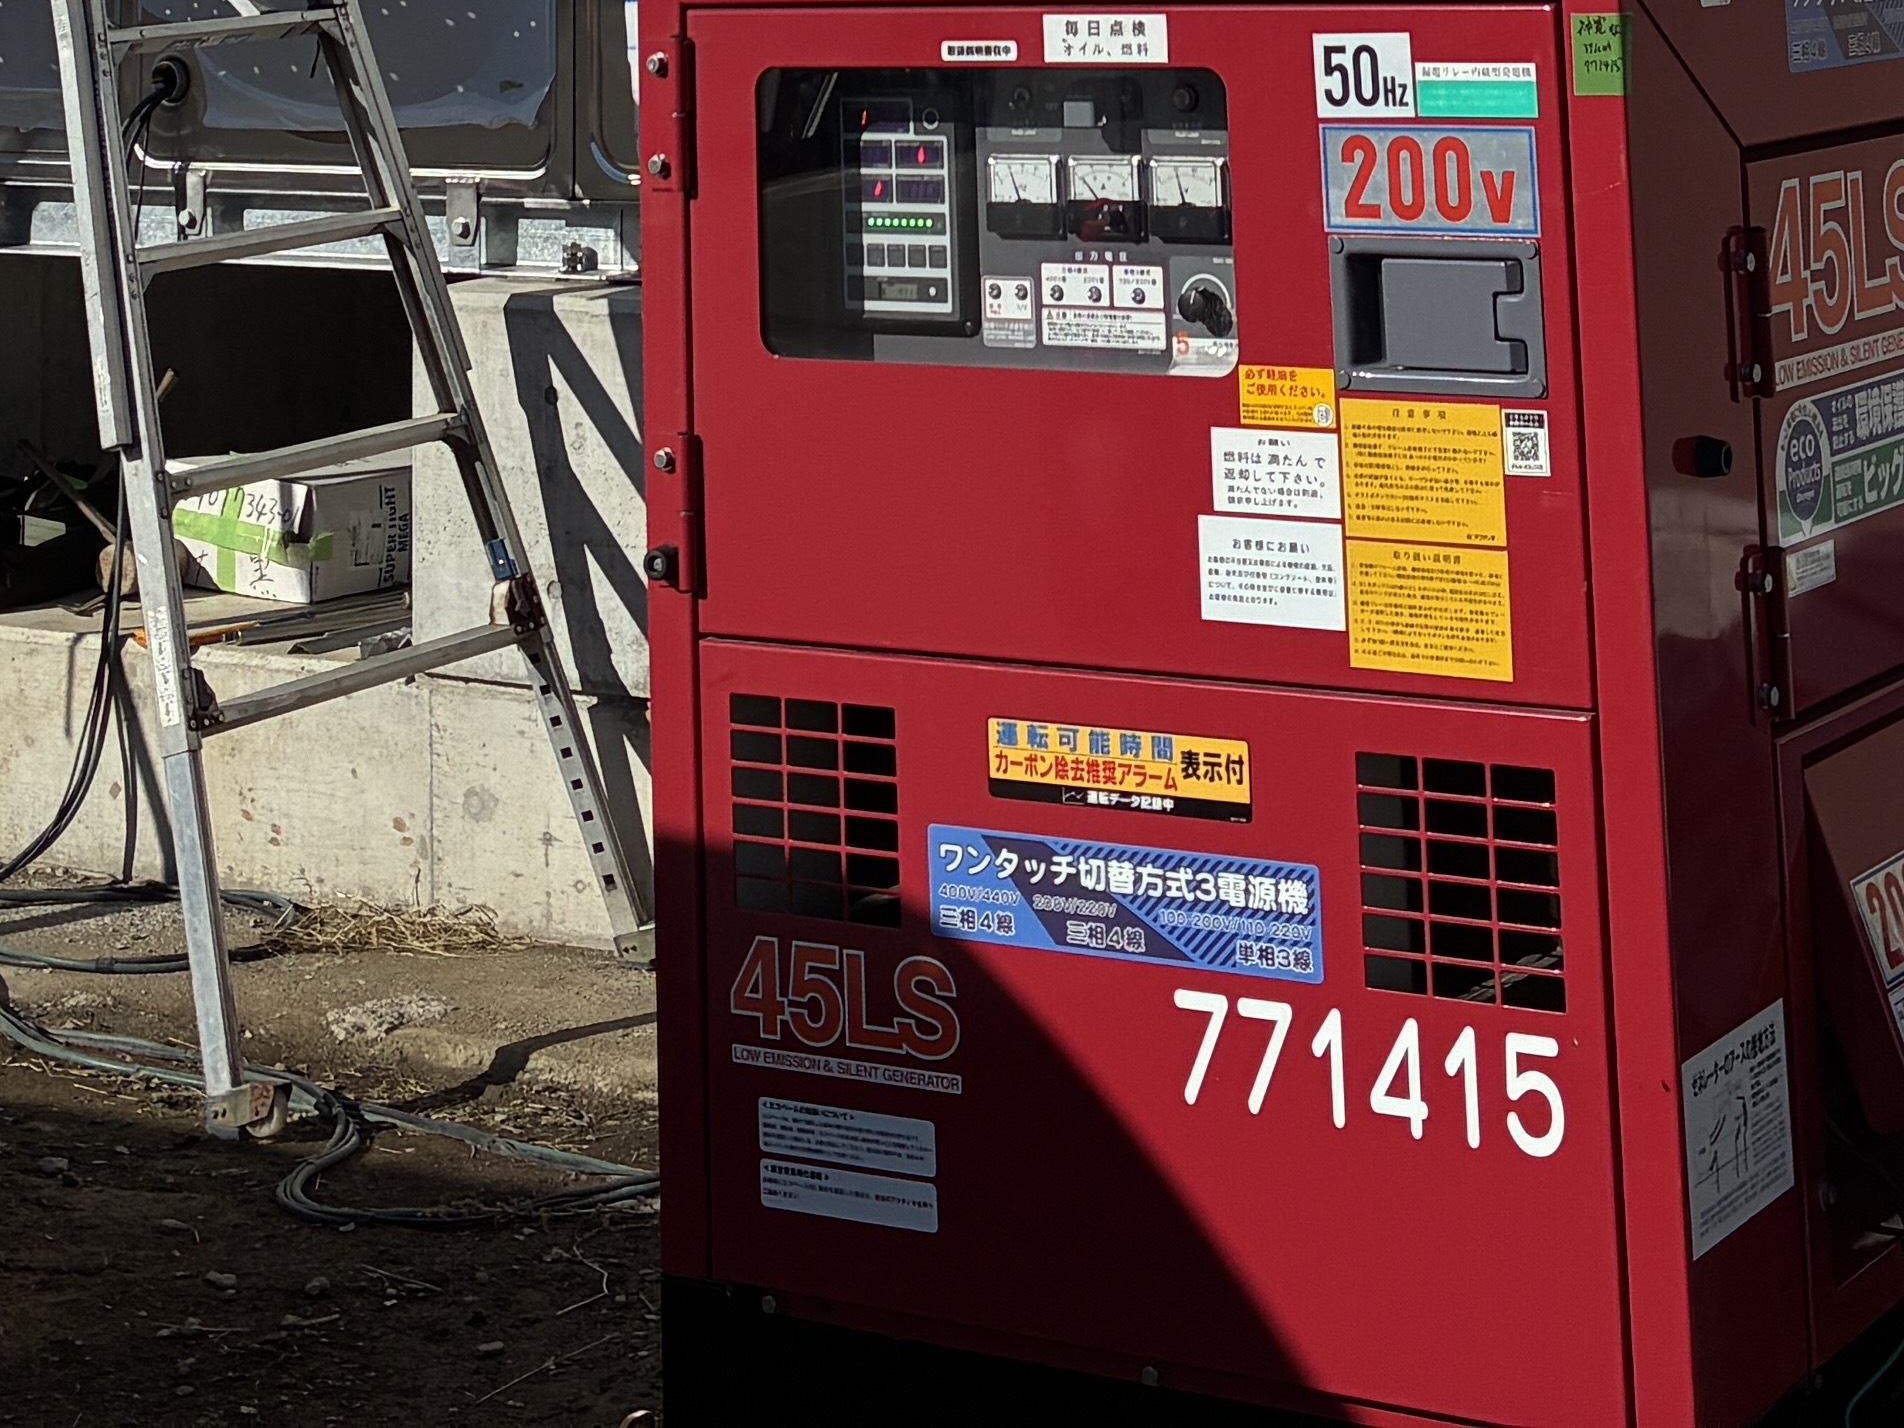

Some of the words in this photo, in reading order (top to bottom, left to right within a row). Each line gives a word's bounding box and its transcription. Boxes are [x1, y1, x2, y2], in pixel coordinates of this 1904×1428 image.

[1322, 44, 1410, 108] 50Hz
[1789, 433, 1815, 463] eco
[397, 512, 410, 553] MEGA
[995, 721, 1175, 762] 運転可能時間
[994, 749, 1178, 792] カーボン除去推奨アラーム
[1179, 749, 1245, 786] 表示付
[938, 843, 1310, 916] ワンタッチ切替方式3電源機
[938, 905, 1015, 936] 三相4線
[1066, 921, 1146, 953] 三相4線
[730, 935, 961, 1061] 45LS
[734, 1045, 761, 1063] LOW
[763, 1050, 821, 1073] EMISSION
[837, 1061, 881, 1081] SILENT
[882, 1067, 961, 1093] GENERATOR
[1173, 987, 1566, 1158] 771415
